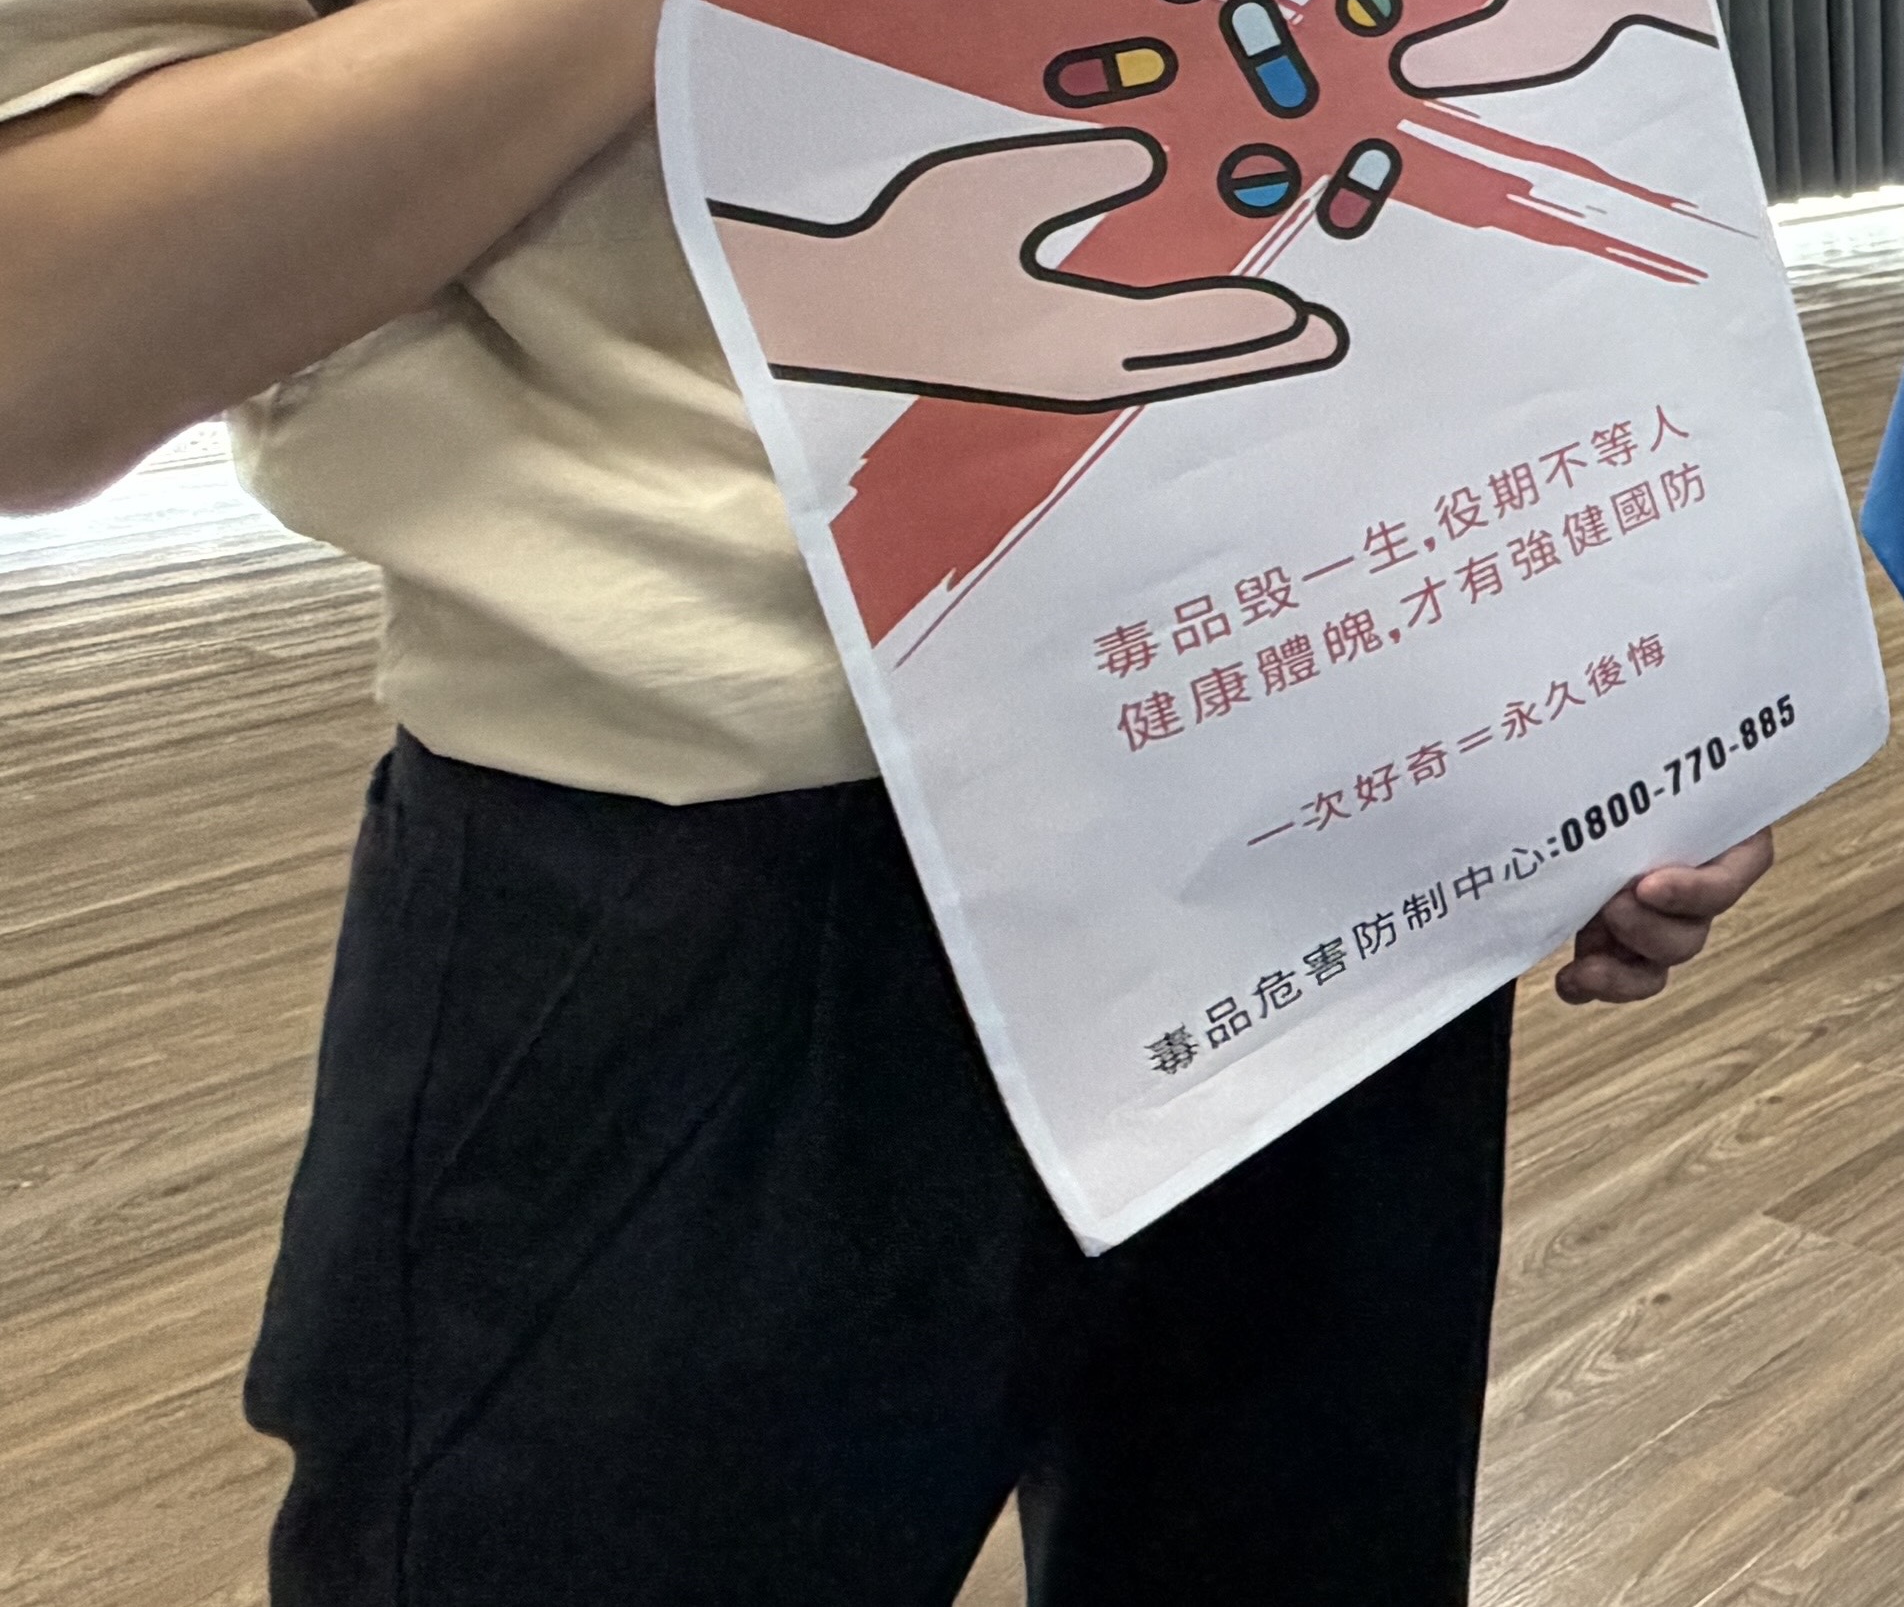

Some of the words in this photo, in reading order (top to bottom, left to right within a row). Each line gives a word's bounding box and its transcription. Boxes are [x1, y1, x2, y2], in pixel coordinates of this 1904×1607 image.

[1092, 403, 1692, 679] 毒品毀一生,役期不等人
[1115, 461, 1708, 753] 健康體魄,才有強健國防
